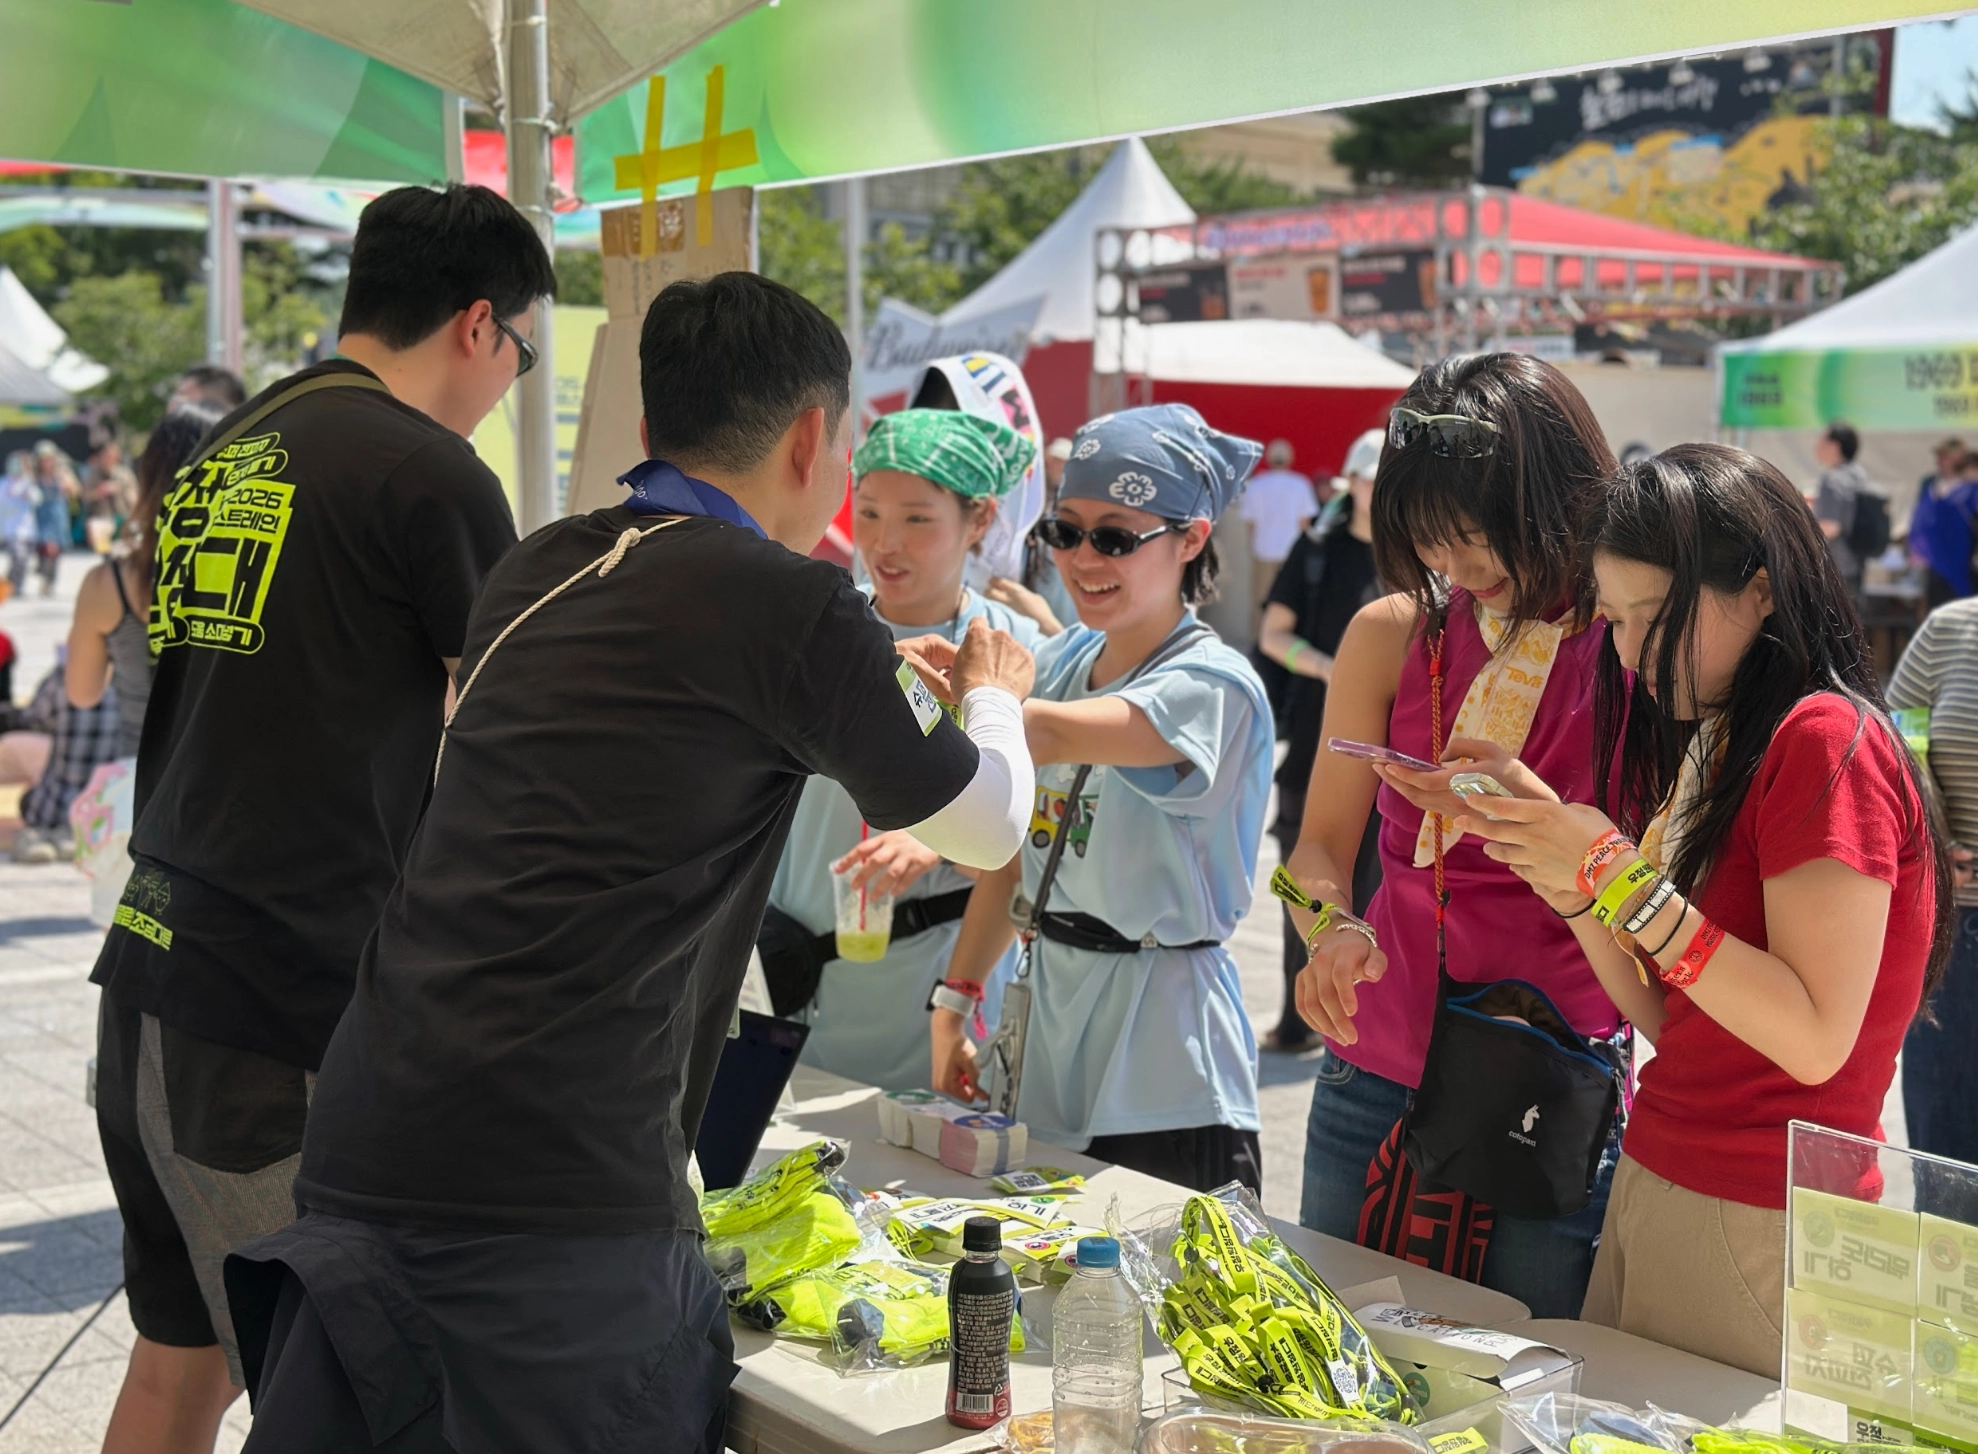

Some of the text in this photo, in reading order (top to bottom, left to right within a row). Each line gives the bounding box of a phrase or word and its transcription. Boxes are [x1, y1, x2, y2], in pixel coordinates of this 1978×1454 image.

[226, 488, 284, 510] 2026
[212, 509, 281, 534] 스트레인
[1584, 861, 1597, 880] DMZ
[1593, 844, 1613, 866] PEACE
[1627, 862, 1655, 884] 우정원
[1508, 1130, 1537, 1147] cotopaxi
